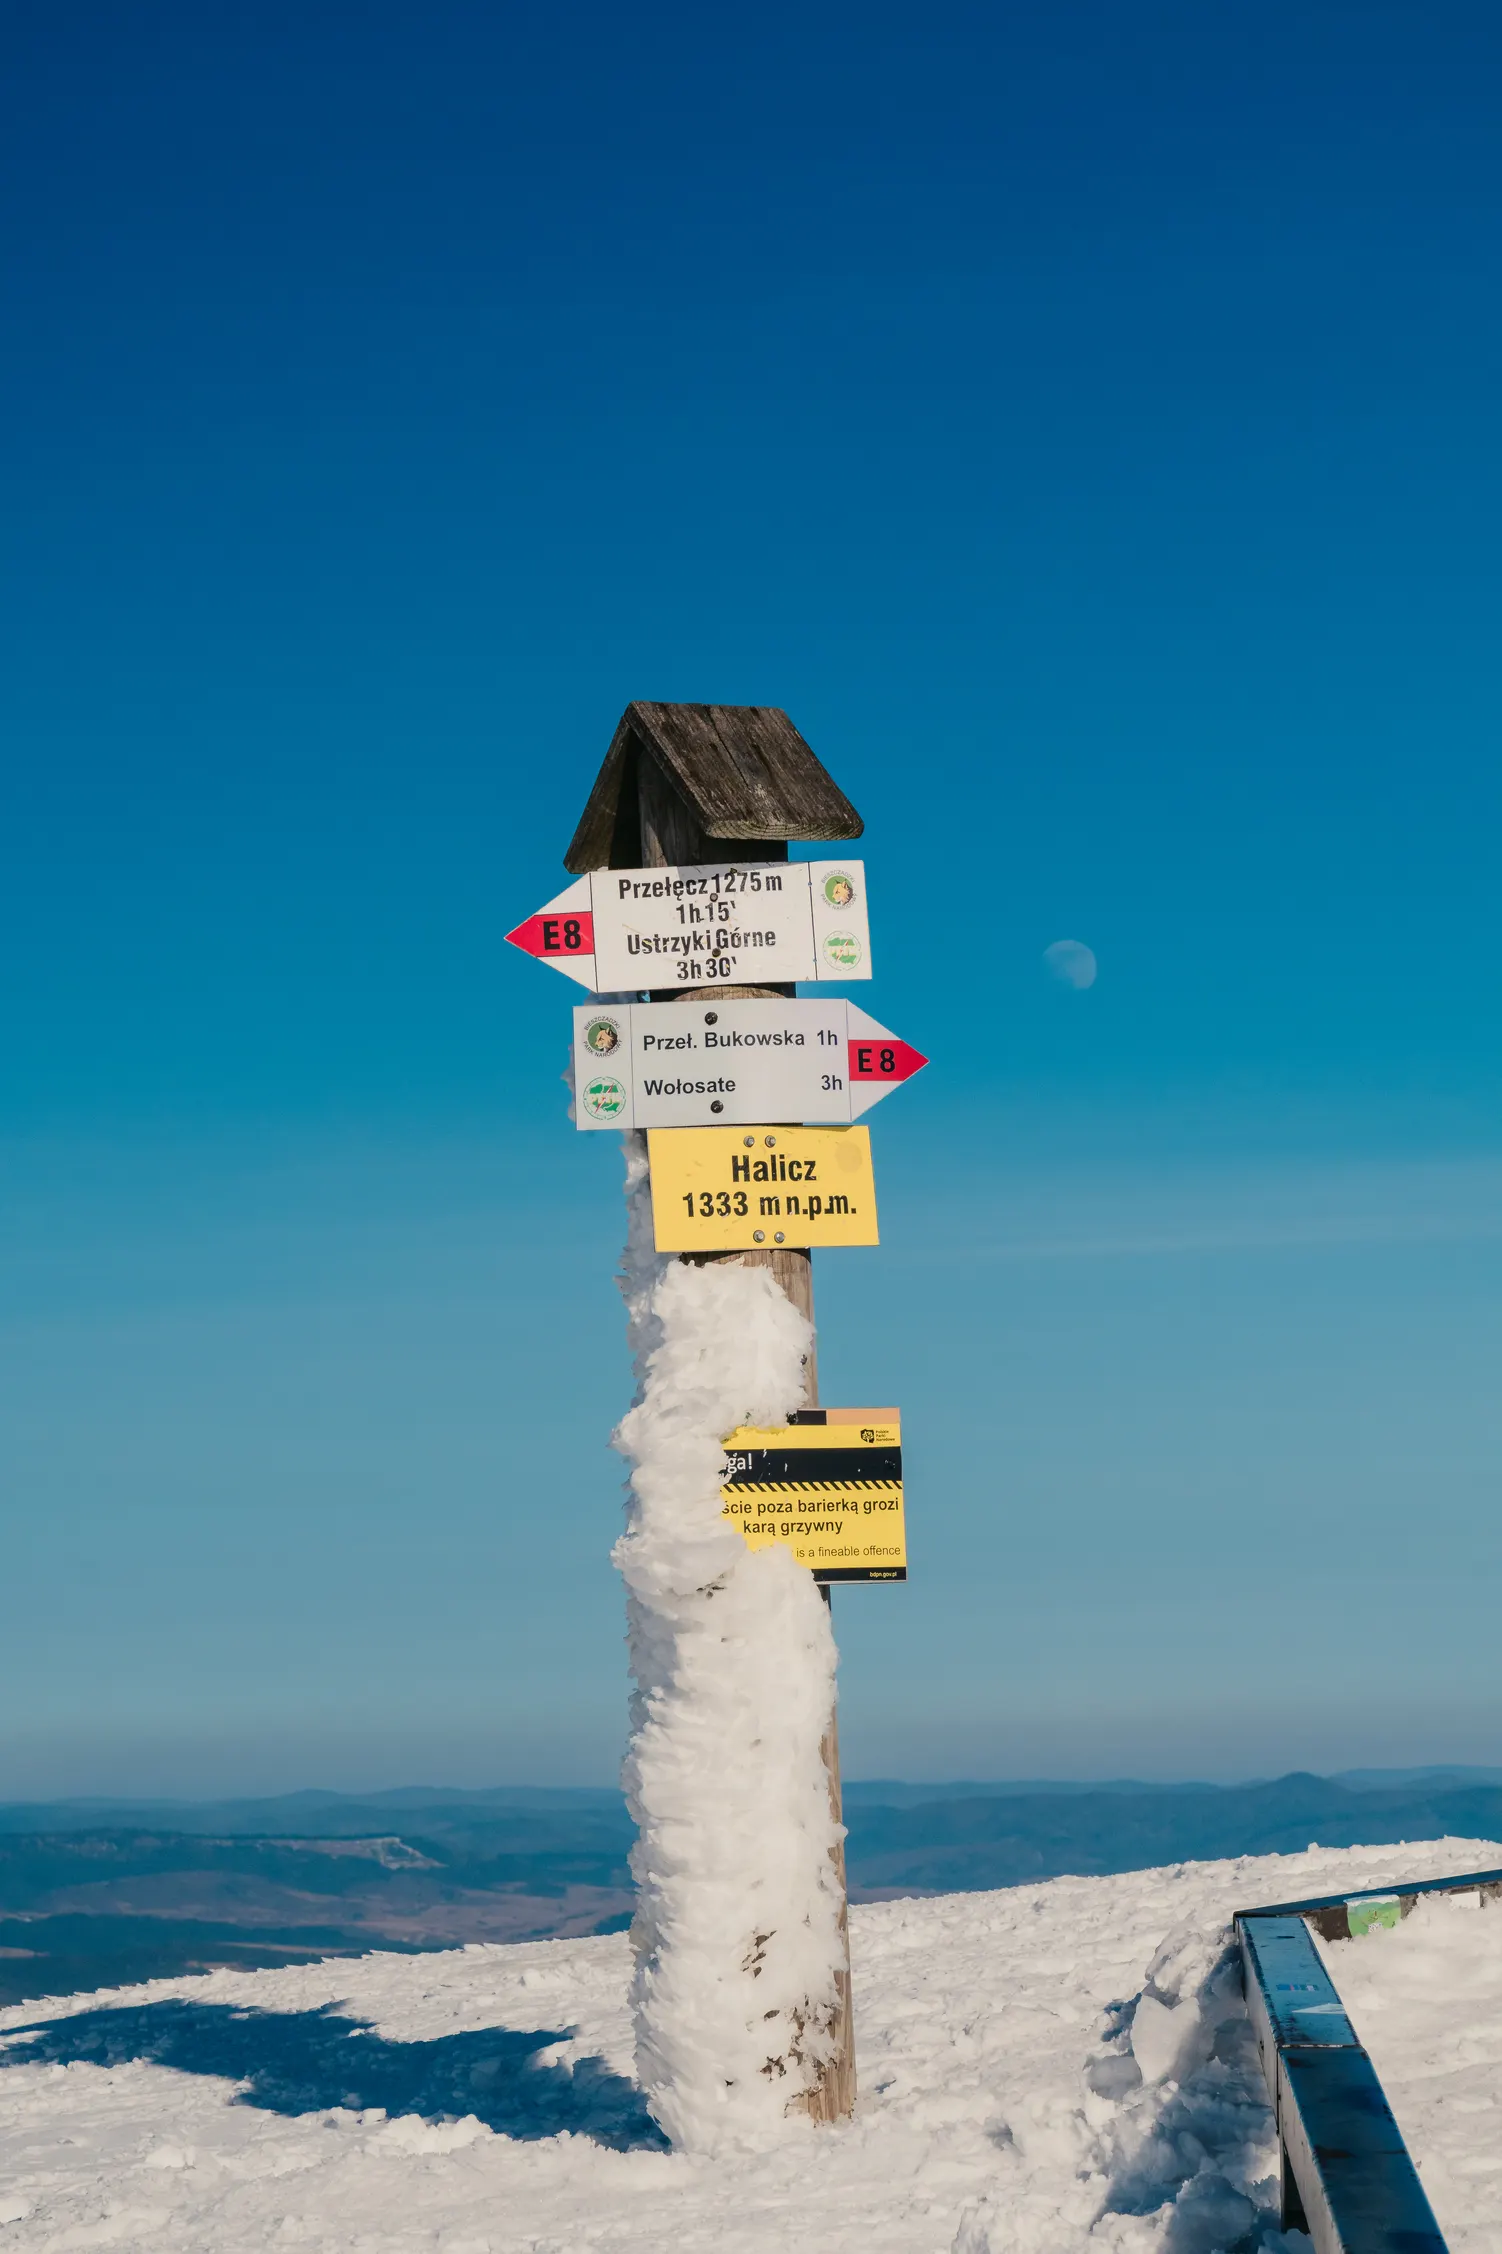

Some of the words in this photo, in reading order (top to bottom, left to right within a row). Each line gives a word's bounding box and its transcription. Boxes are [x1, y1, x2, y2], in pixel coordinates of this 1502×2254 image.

[618, 876, 709, 901] Przełęcz
[711, 871, 763, 894] 1275
[765, 874, 783, 892] m
[675, 903, 701, 924] 1h
[627, 929, 712, 956] Ustrzyki
[715, 926, 777, 951] Górne
[676, 960, 702, 980] 3h
[583, 1015, 620, 1031] BIESZCZADZKI
[594, 1039, 622, 1058] NARODOWY
[643, 1033, 697, 1051] Przeł.
[704, 1029, 805, 1049] Bukowska
[816, 1029, 838, 1046] 1h
[643, 1076, 737, 1096] Wołosate
[820, 1074, 843, 1092] 3h
[731, 1154, 817, 1182] Halicz
[682, 1191, 749, 1218] 1333
[757, 1501, 793, 1516] poza
[798, 1498, 859, 1515] barierką
[863, 1497, 900, 1515] grozi
[743, 1520, 776, 1536] karą
[780, 1520, 844, 1536] grzywny
[796, 1547, 805, 1558] is
[808, 1549, 815, 1558] a
[818, 1546, 860, 1557] fineable
[862, 1545, 901, 1557] offence
